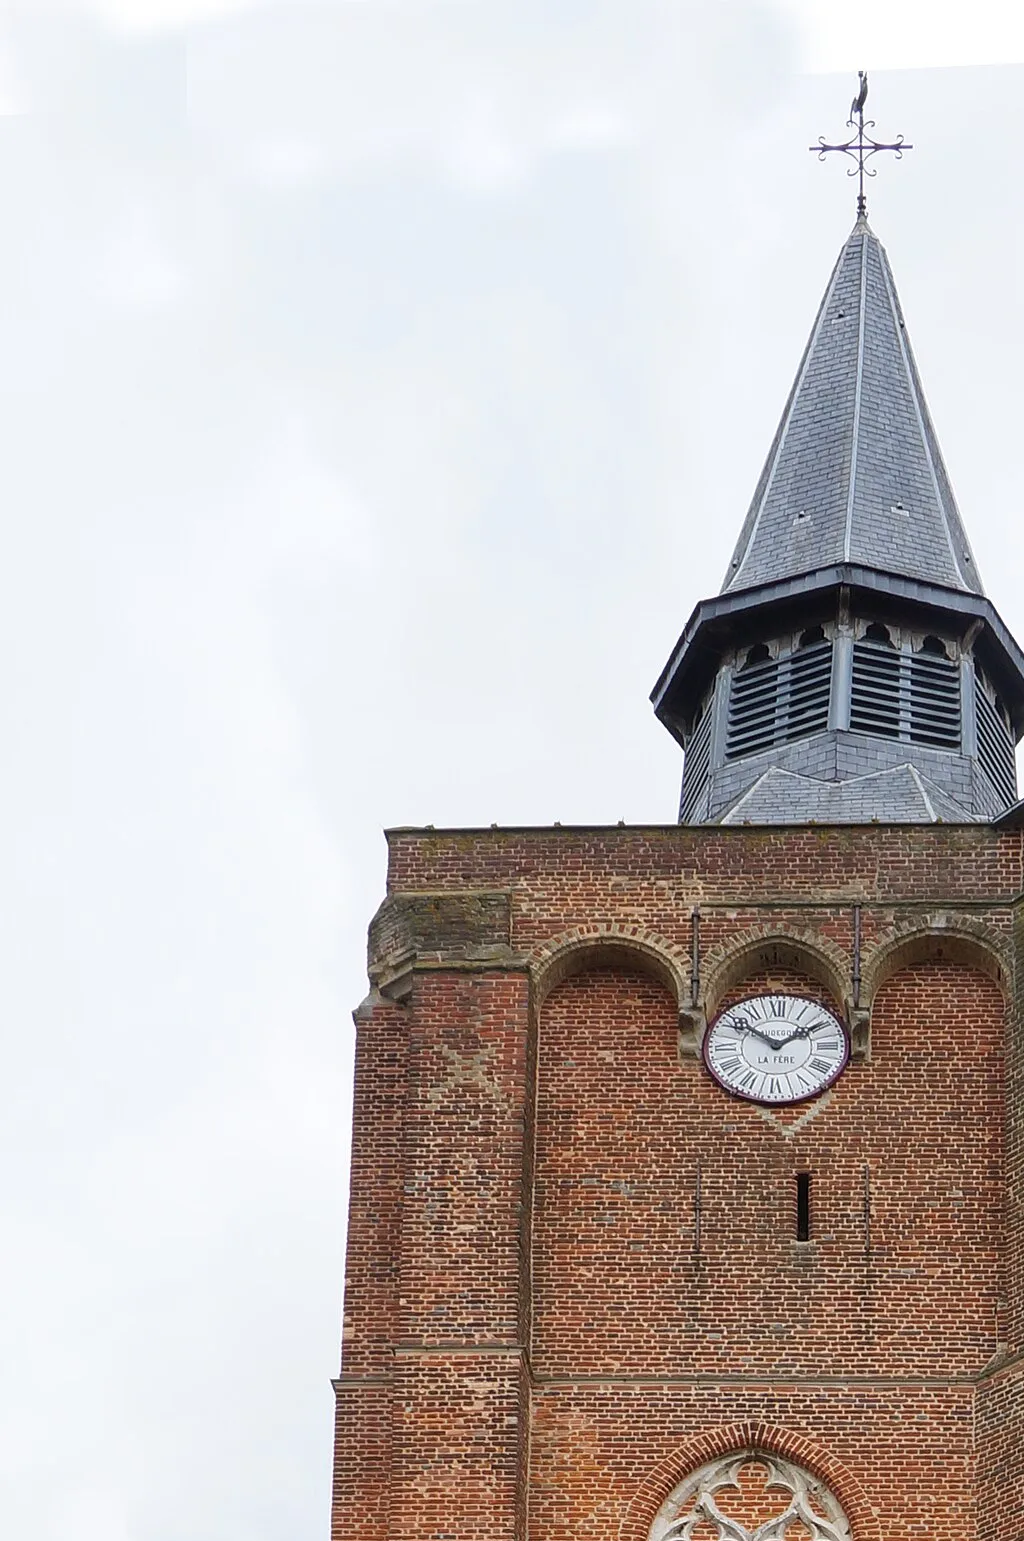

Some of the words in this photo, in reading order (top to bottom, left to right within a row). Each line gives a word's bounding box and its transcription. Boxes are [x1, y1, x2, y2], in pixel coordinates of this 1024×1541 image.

[743, 1004, 762, 1023] XI
[769, 1000, 787, 1017] XII
[795, 1005, 809, 1021] I
[714, 1040, 737, 1052] IX
[816, 1041, 839, 1051] III
[719, 1057, 743, 1077] VIII
[758, 1056, 769, 1064] LA
[773, 1054, 796, 1064] FÈRE
[808, 1057, 833, 1075] IIII
[739, 1072, 759, 1090] VII
[769, 1077, 782, 1094] VI
[796, 1073, 811, 1090] V
